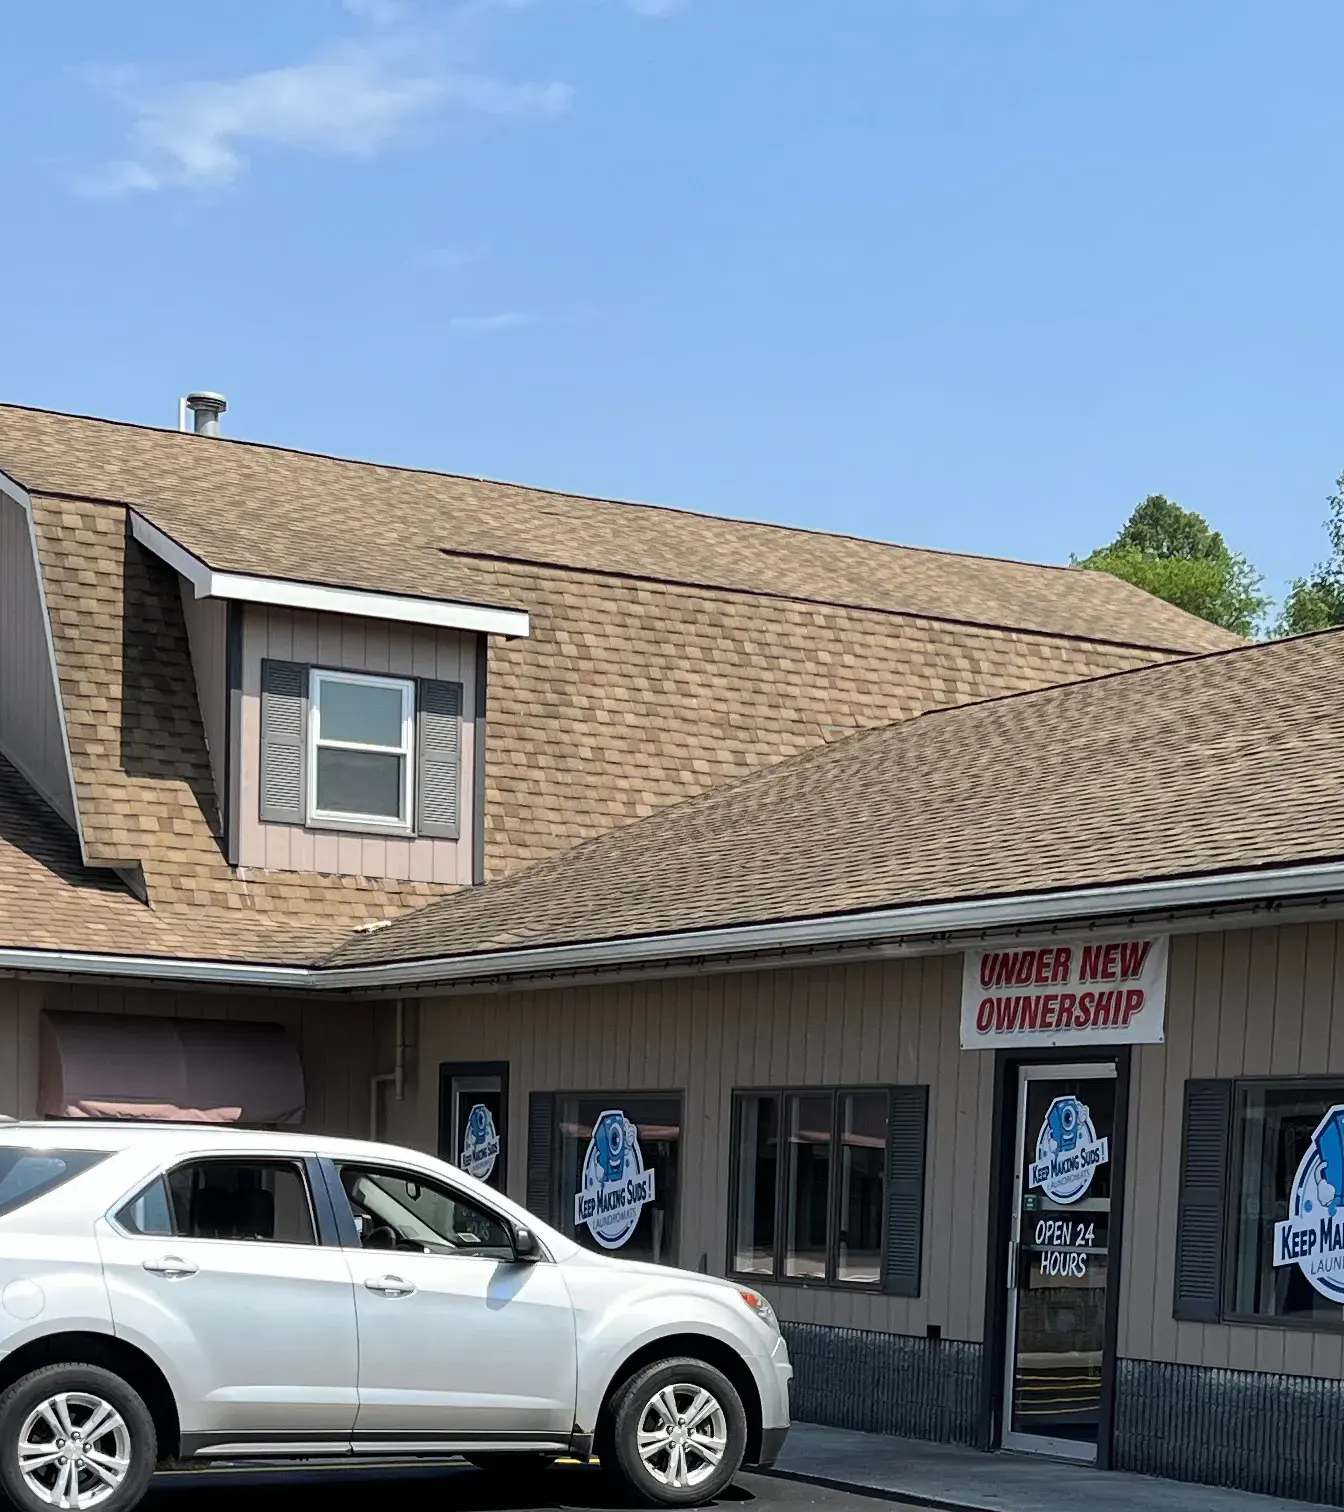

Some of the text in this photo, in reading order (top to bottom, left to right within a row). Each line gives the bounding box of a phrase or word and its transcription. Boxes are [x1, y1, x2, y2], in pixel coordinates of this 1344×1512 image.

[980, 941, 1151, 987] UNDER NEW
[976, 989, 1145, 1033] OWNERSHIP
[1035, 1220, 1095, 1247] OPEN 24
[1039, 1250, 1087, 1278] HOURS
